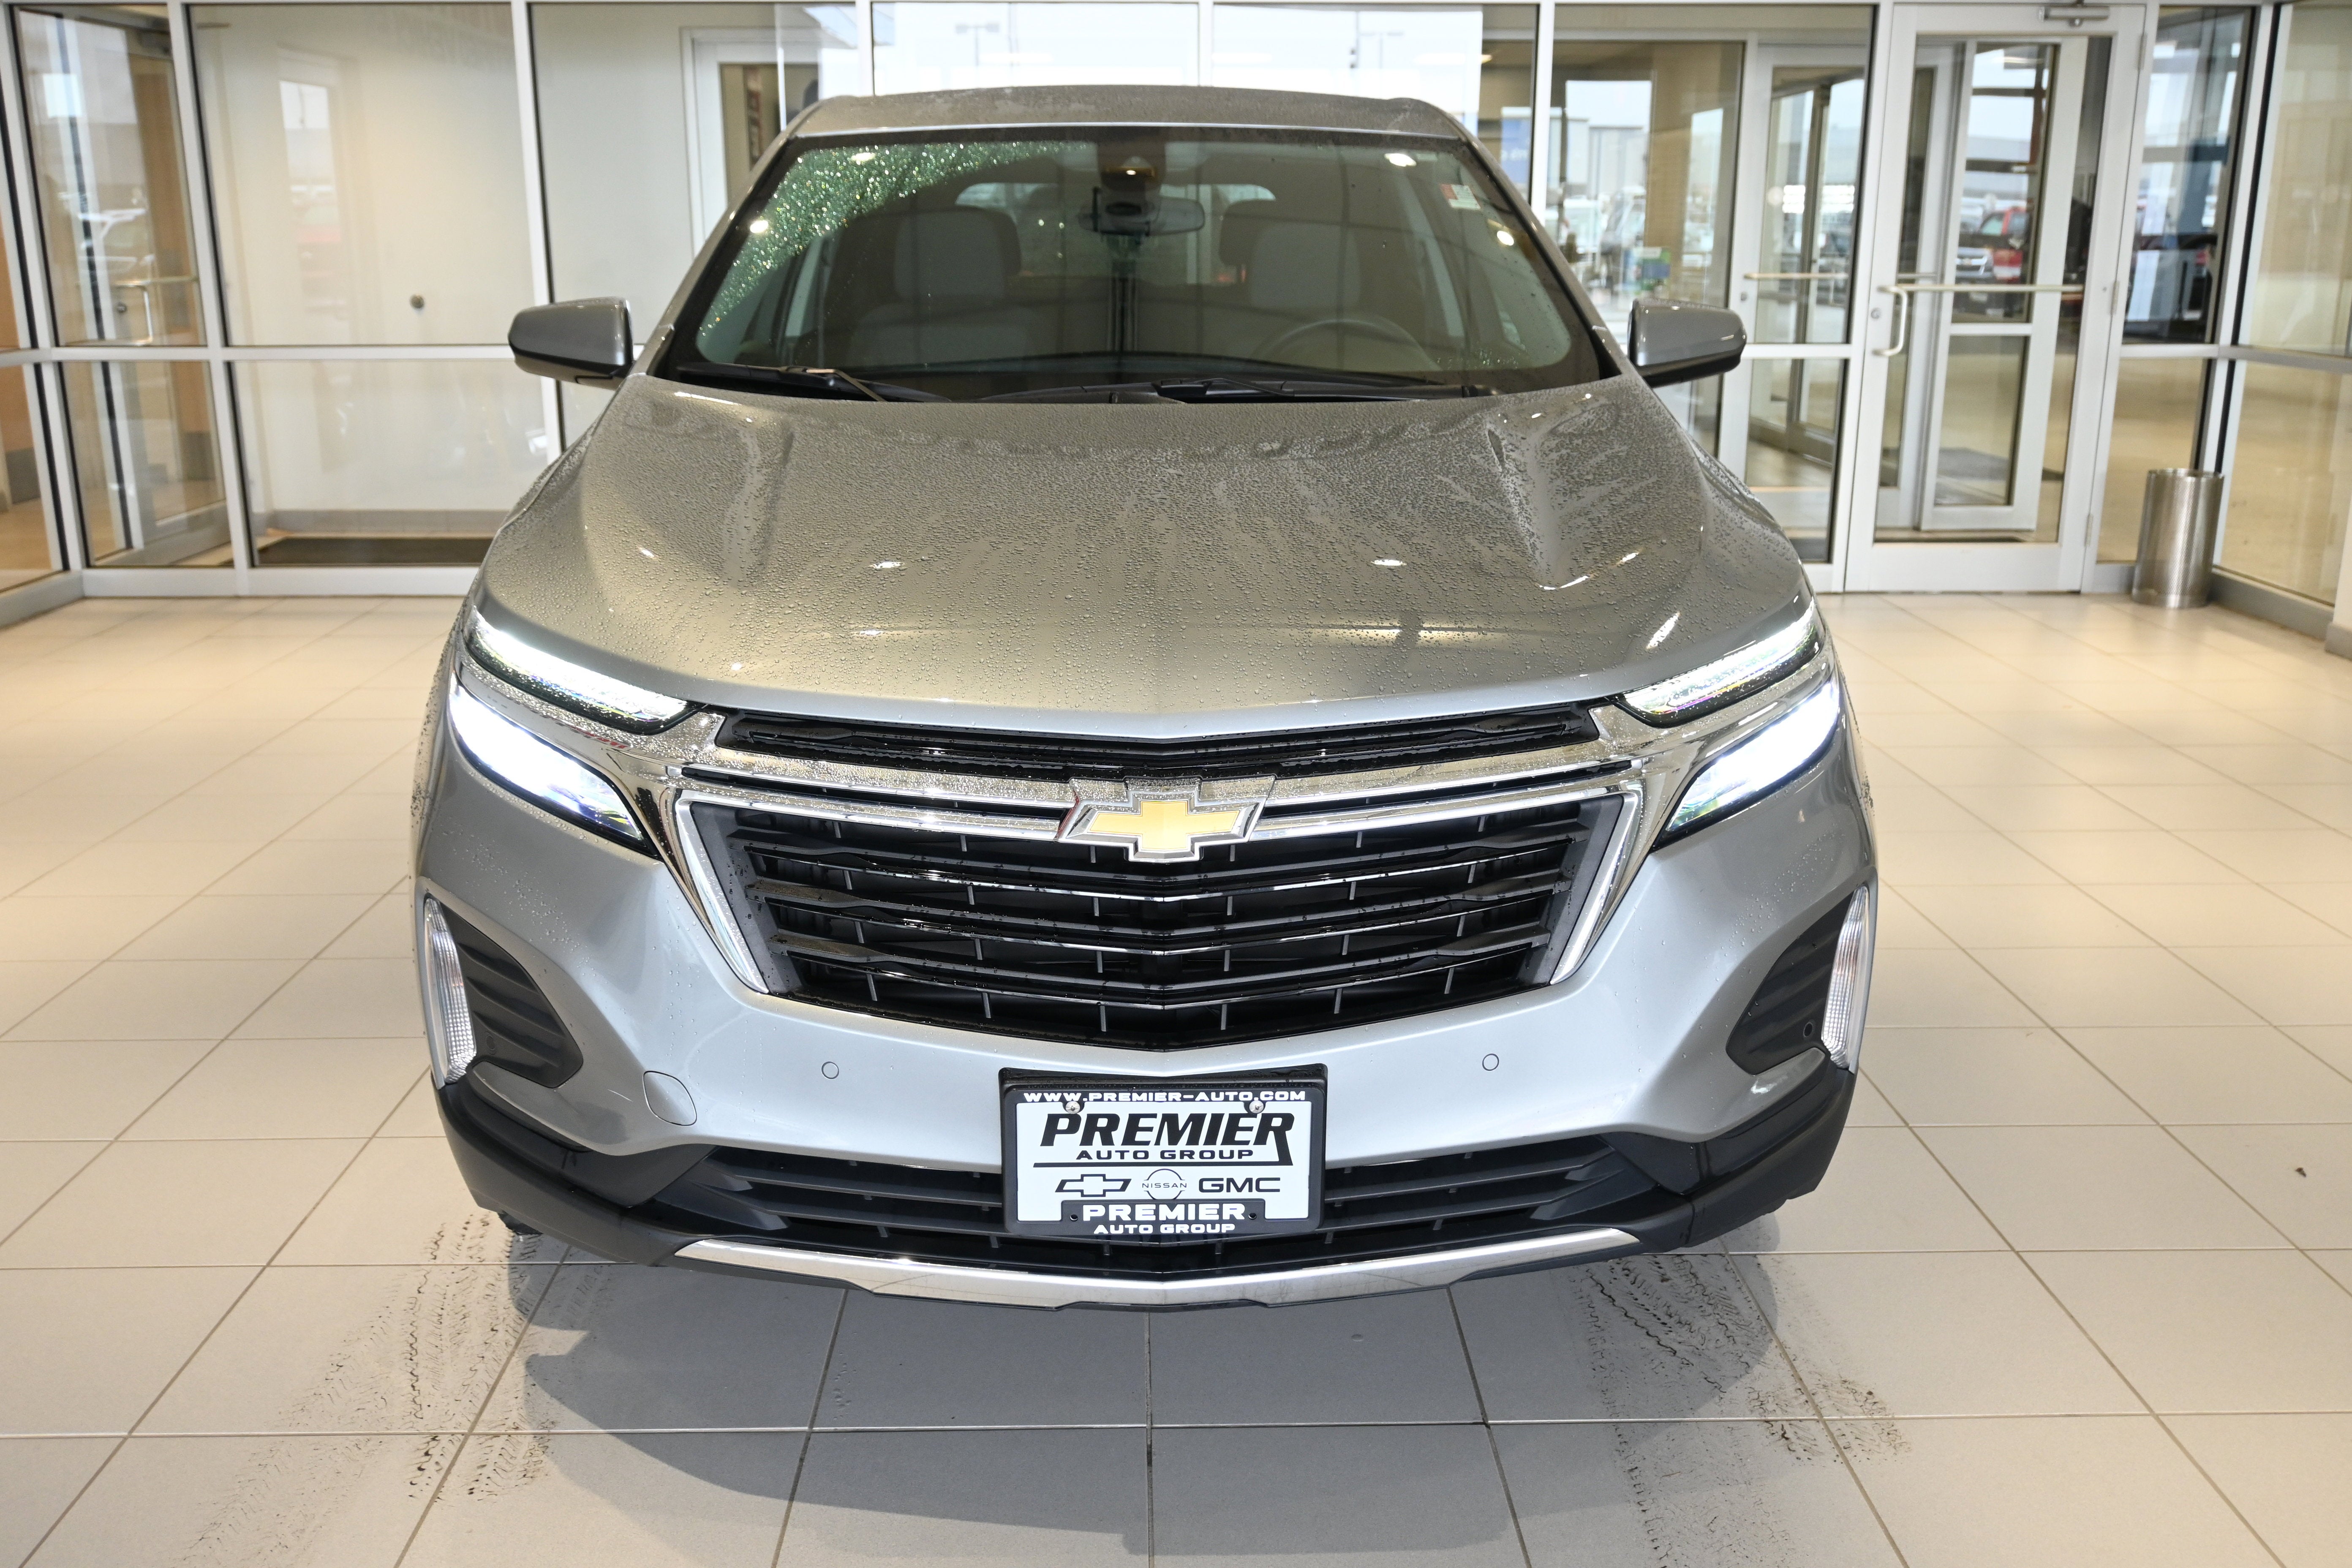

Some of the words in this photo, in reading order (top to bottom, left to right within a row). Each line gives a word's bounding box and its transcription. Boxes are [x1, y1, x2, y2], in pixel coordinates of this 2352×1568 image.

[1024, 1091, 1305, 1102] WWW.PREMIER-AUTO.COM
[1040, 1113, 1294, 1165] PREMIER
[1076, 1150, 1149, 1160] AUTO
[1160, 1150, 1253, 1160] GROUP
[1199, 1177, 1280, 1193] GMC
[1083, 1203, 1245, 1221] PREMIER
[1093, 1224, 1153, 1234] AUTO
[1160, 1223, 1235, 1233] GROUP
